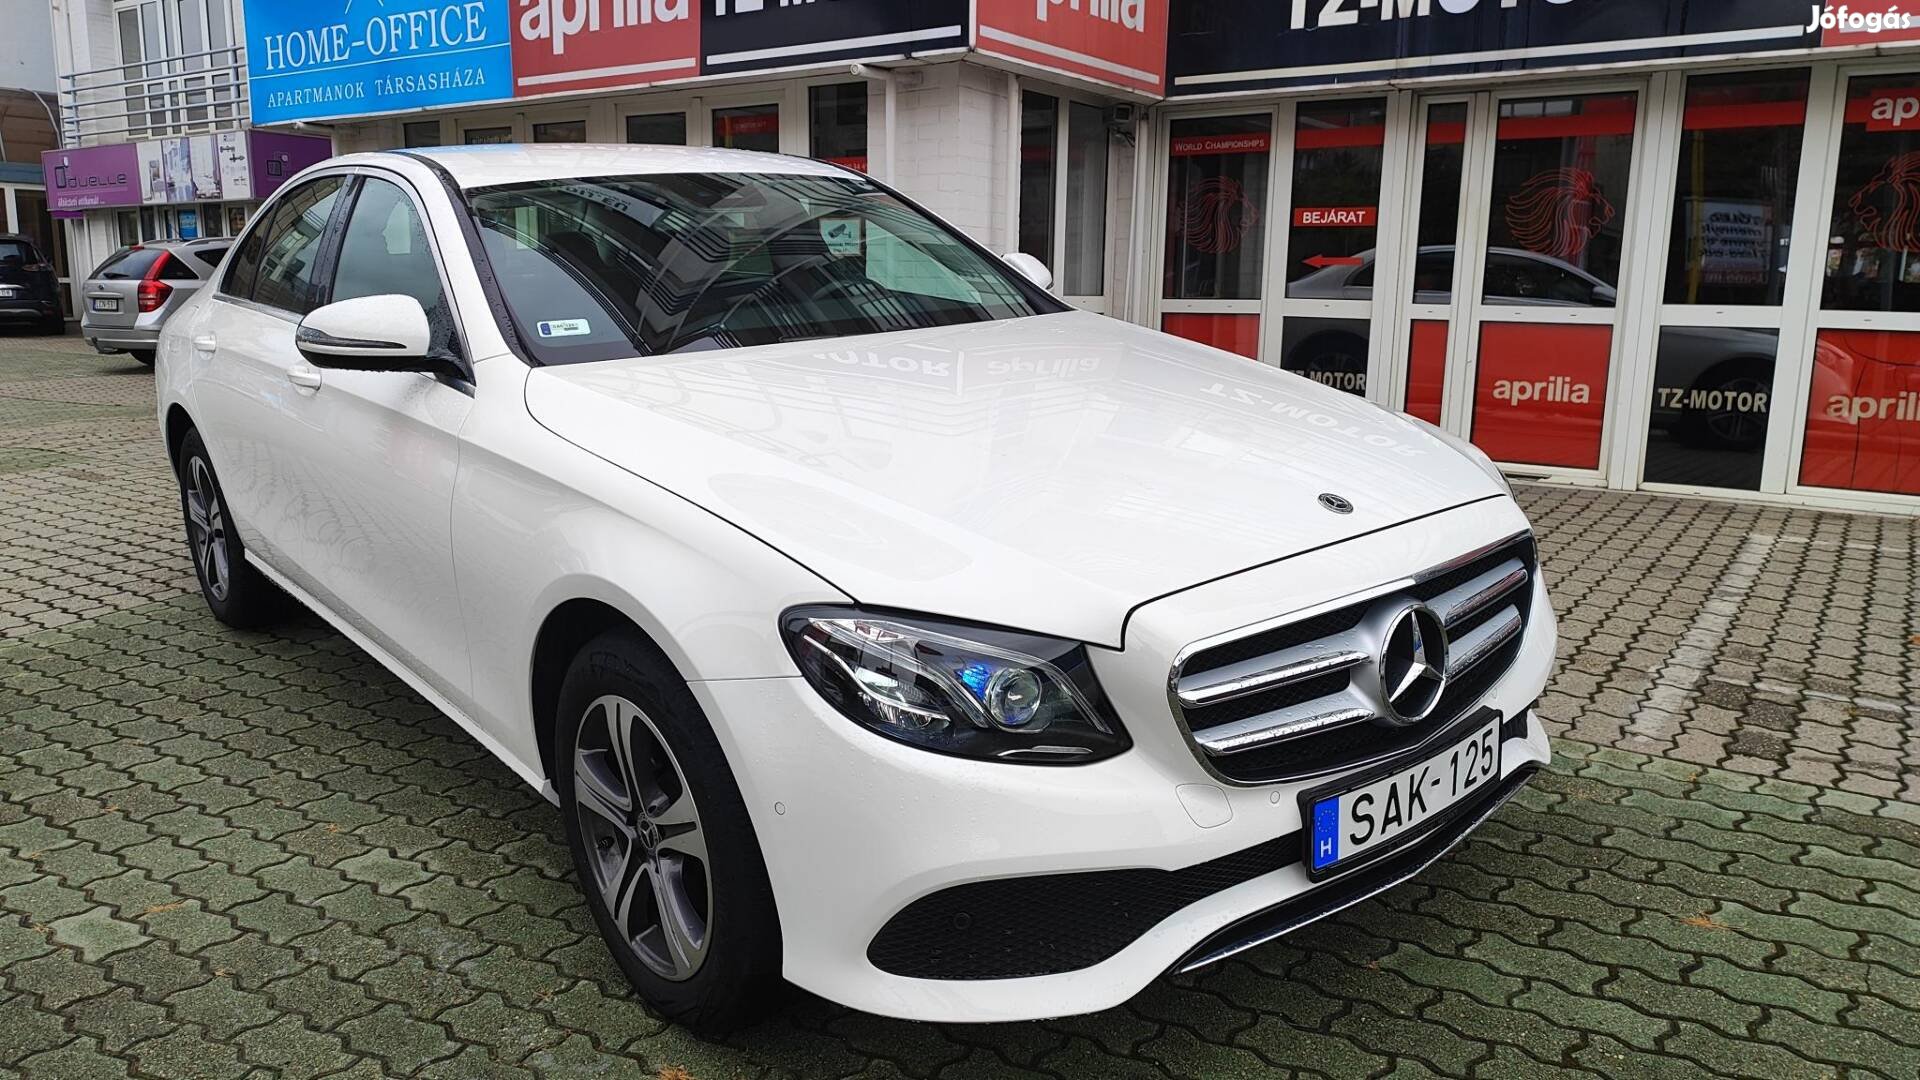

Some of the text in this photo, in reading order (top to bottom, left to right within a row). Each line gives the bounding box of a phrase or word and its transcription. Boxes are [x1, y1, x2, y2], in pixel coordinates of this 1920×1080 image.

[264, 2, 488, 70] HOME-OFFICE
[267, 67, 486, 108] APARTMANOK TÁRSASHÁZA
[1175, 138, 1265, 152] WORLD CHAMPIONSHIPS
[1302, 208, 1366, 224] BEJÁRAT
[1492, 376, 1591, 406] aprilia
[1657, 387, 1768, 413] TZ-MOTOR
[1350, 728, 1493, 846] SAK-125
[1320, 837, 1332, 858] H
